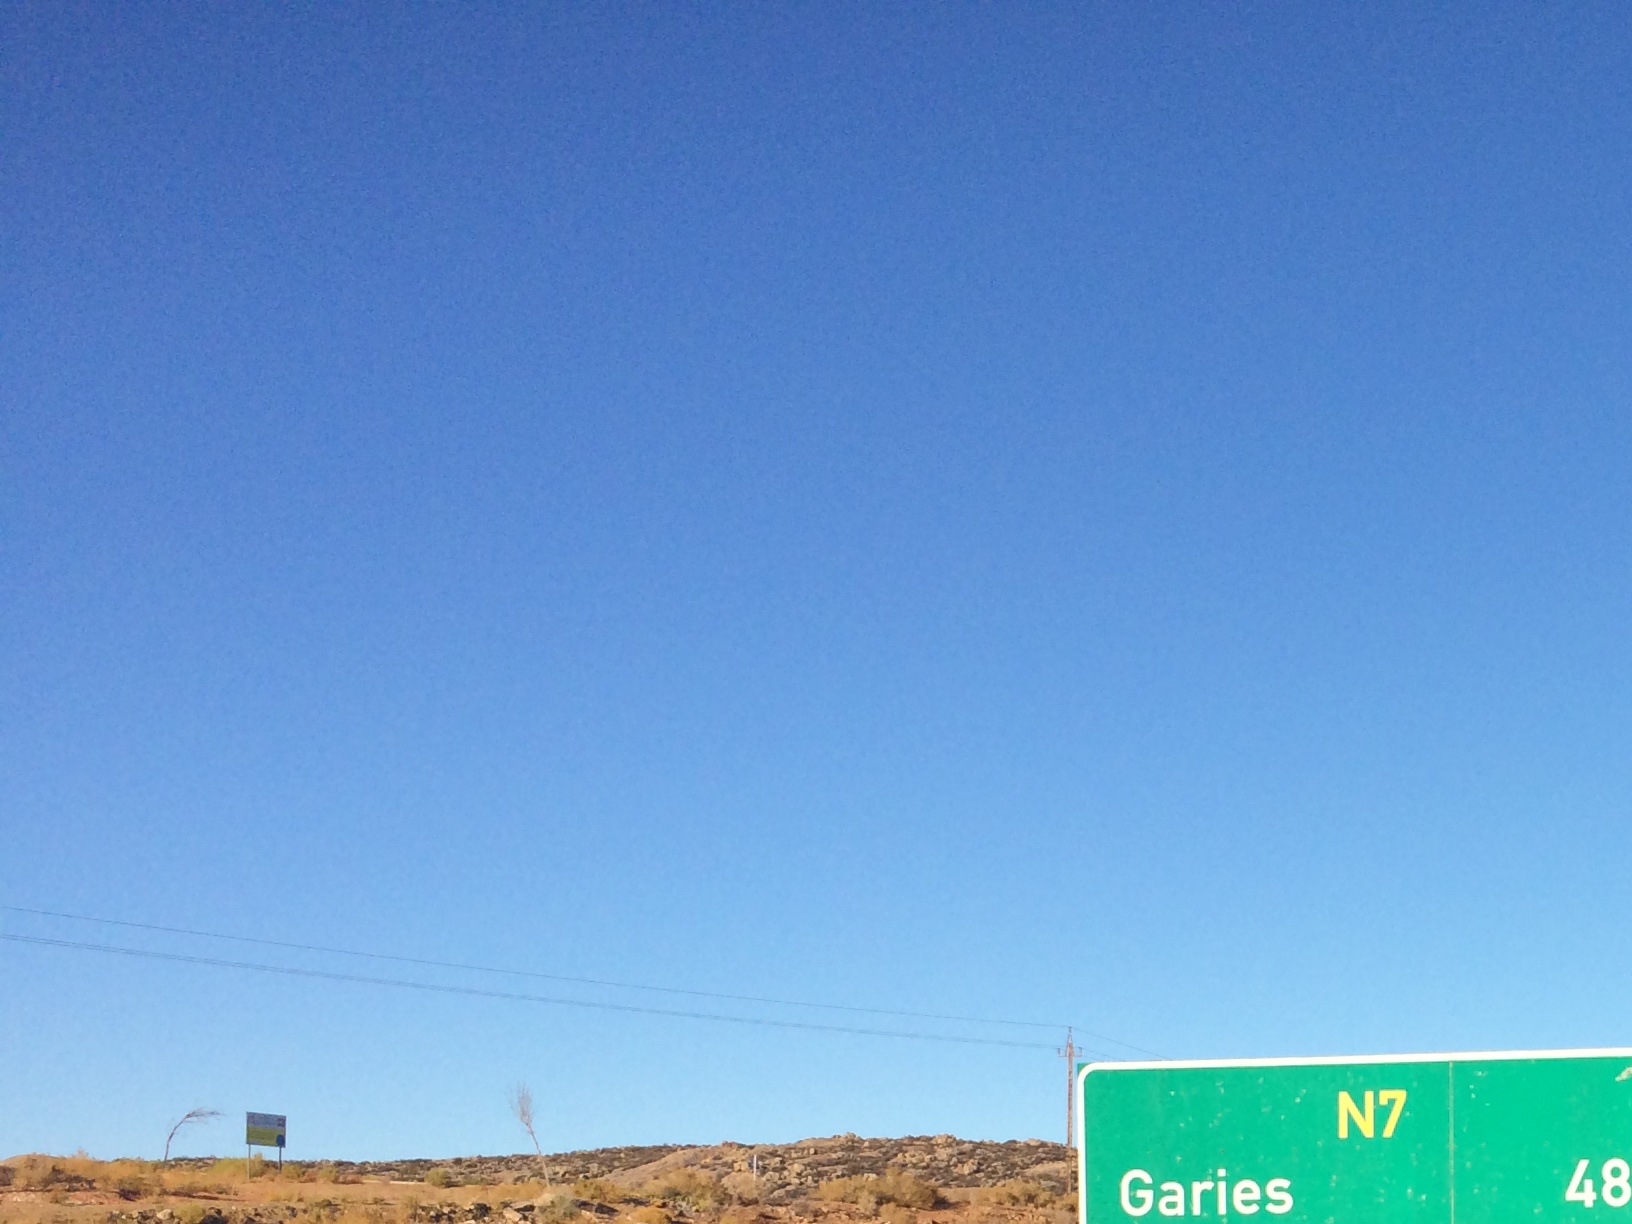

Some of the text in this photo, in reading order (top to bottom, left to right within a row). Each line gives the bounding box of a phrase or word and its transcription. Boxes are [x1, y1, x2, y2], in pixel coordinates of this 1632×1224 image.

[1337, 1089, 1407, 1139] N7
[1119, 1158, 1632, 1217] Garies 48
